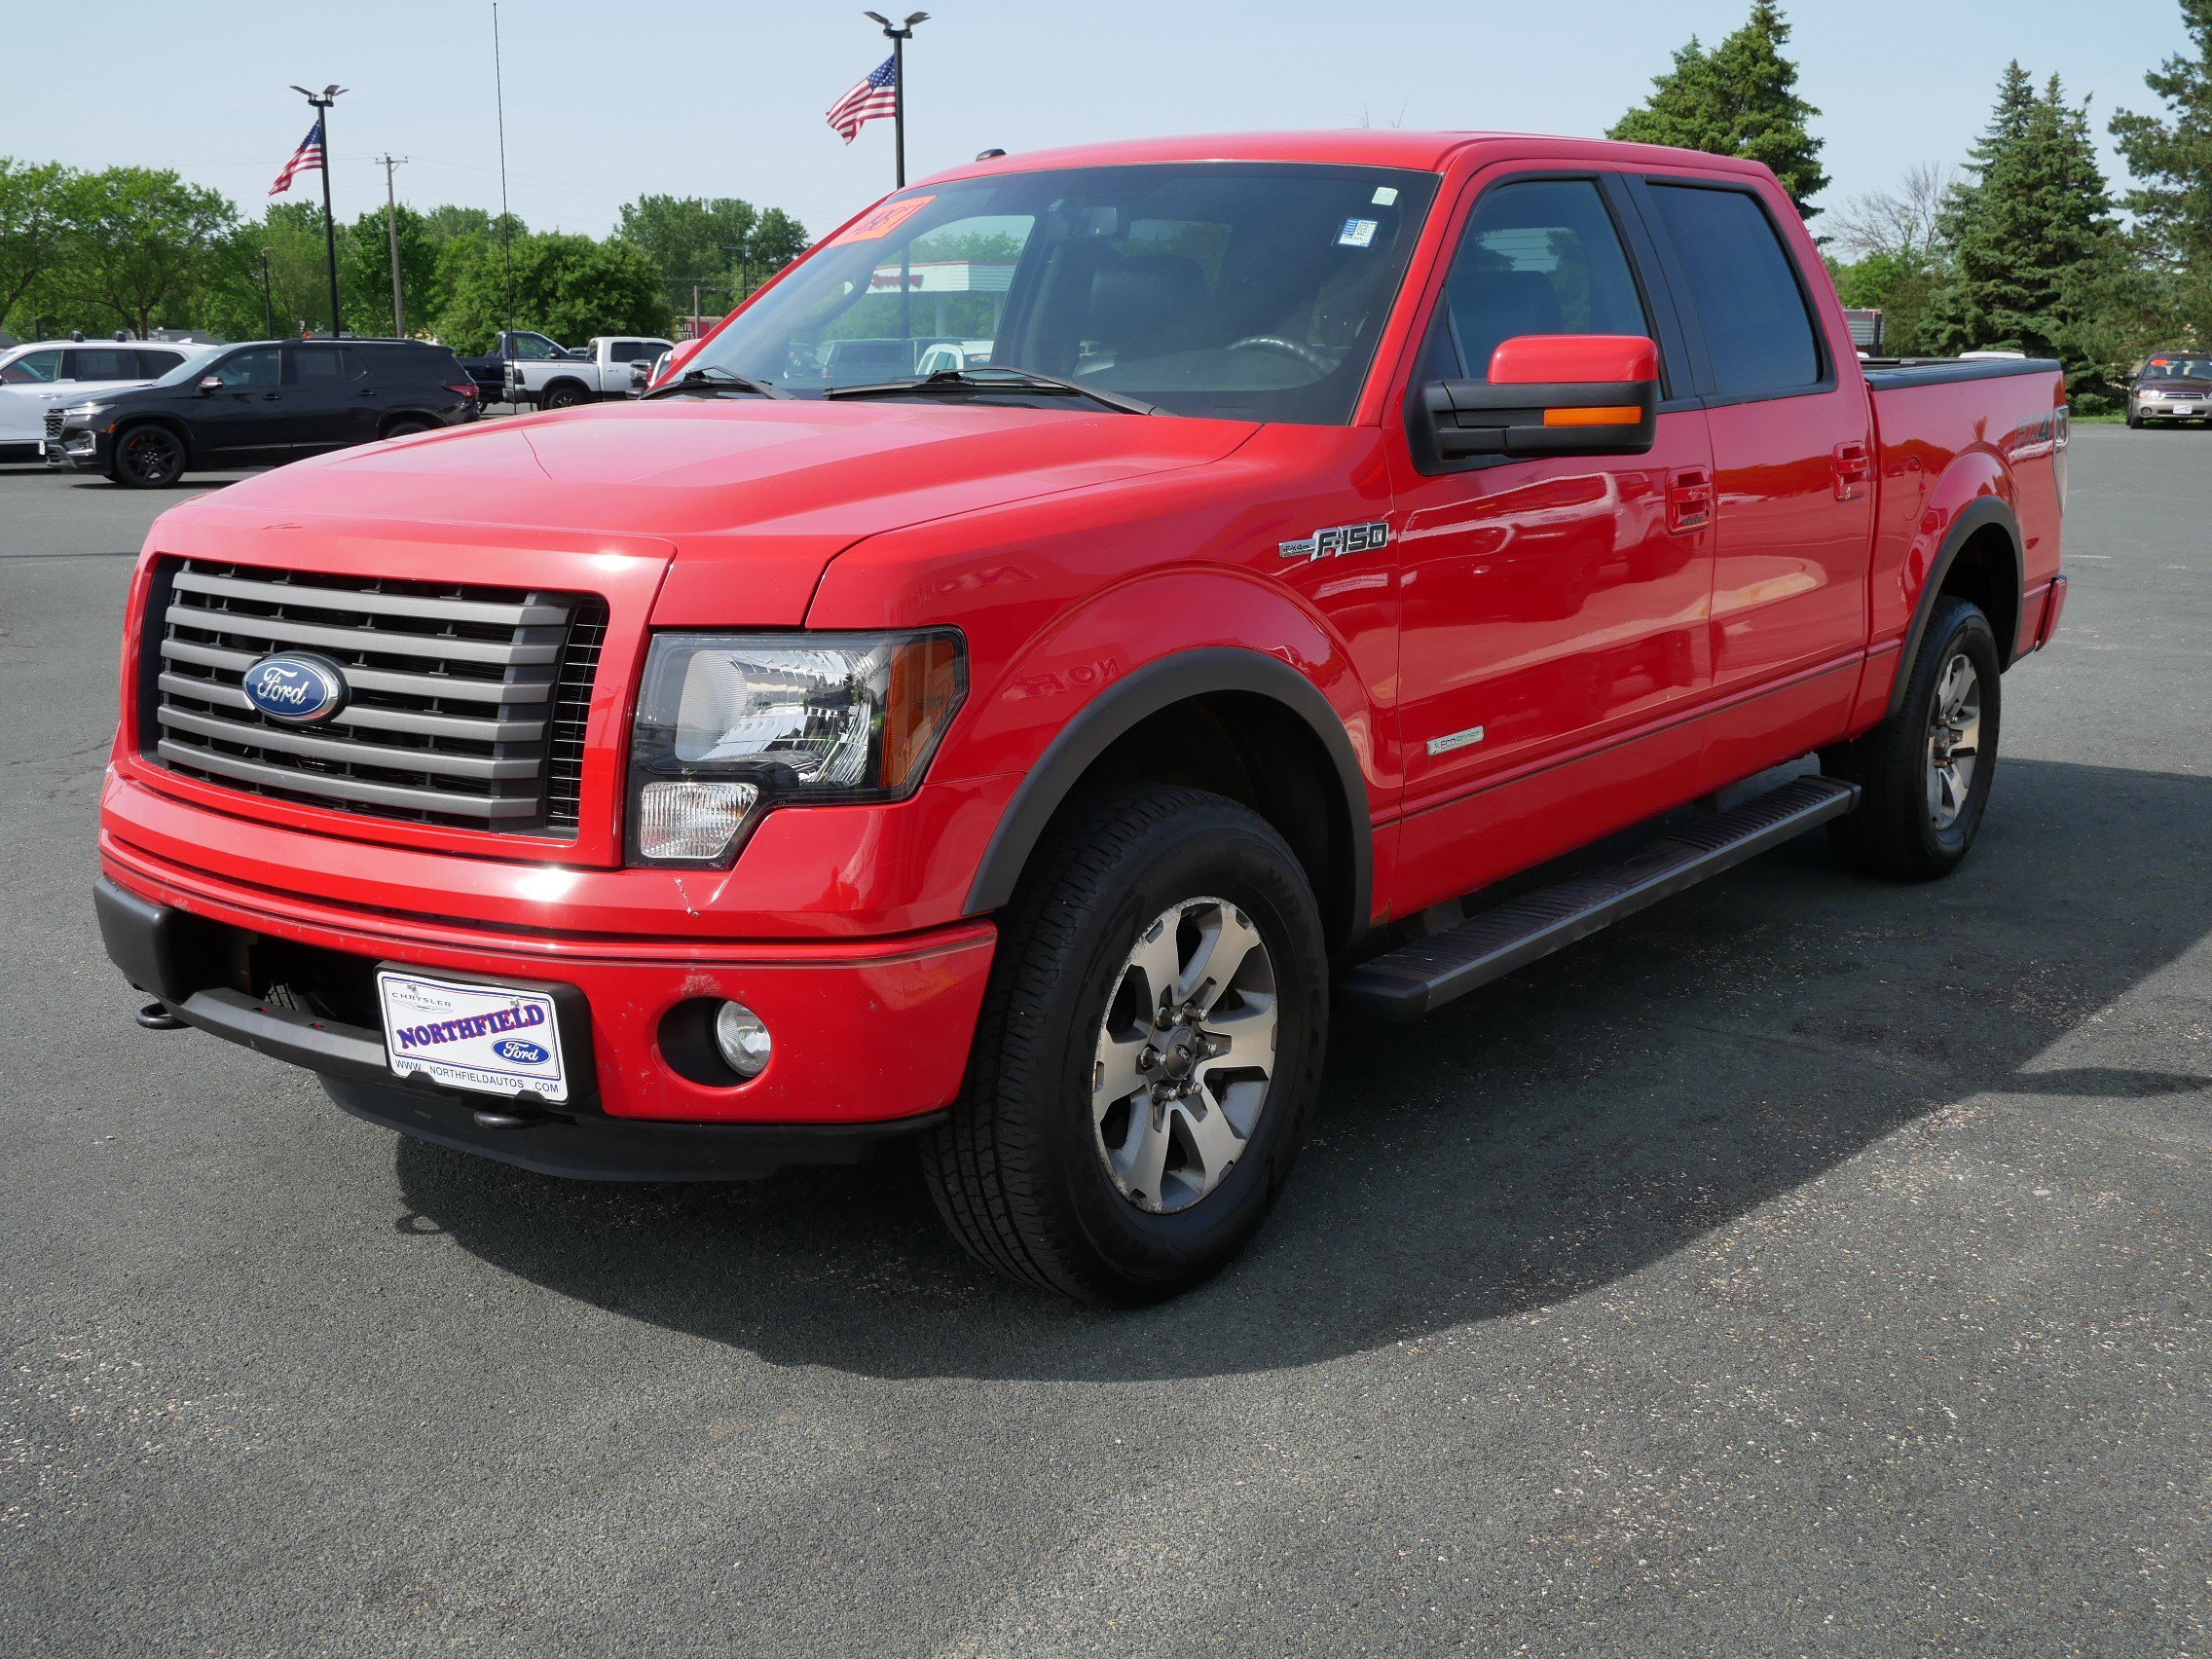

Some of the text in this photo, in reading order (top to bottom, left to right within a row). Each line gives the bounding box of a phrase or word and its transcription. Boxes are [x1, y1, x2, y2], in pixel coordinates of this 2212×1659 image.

[257, 667, 310, 705] Ford
[391, 992, 452, 1008] CHRYSLER
[396, 1004, 545, 1050] NORTHFIELD
[502, 1042, 539, 1061] Ford
